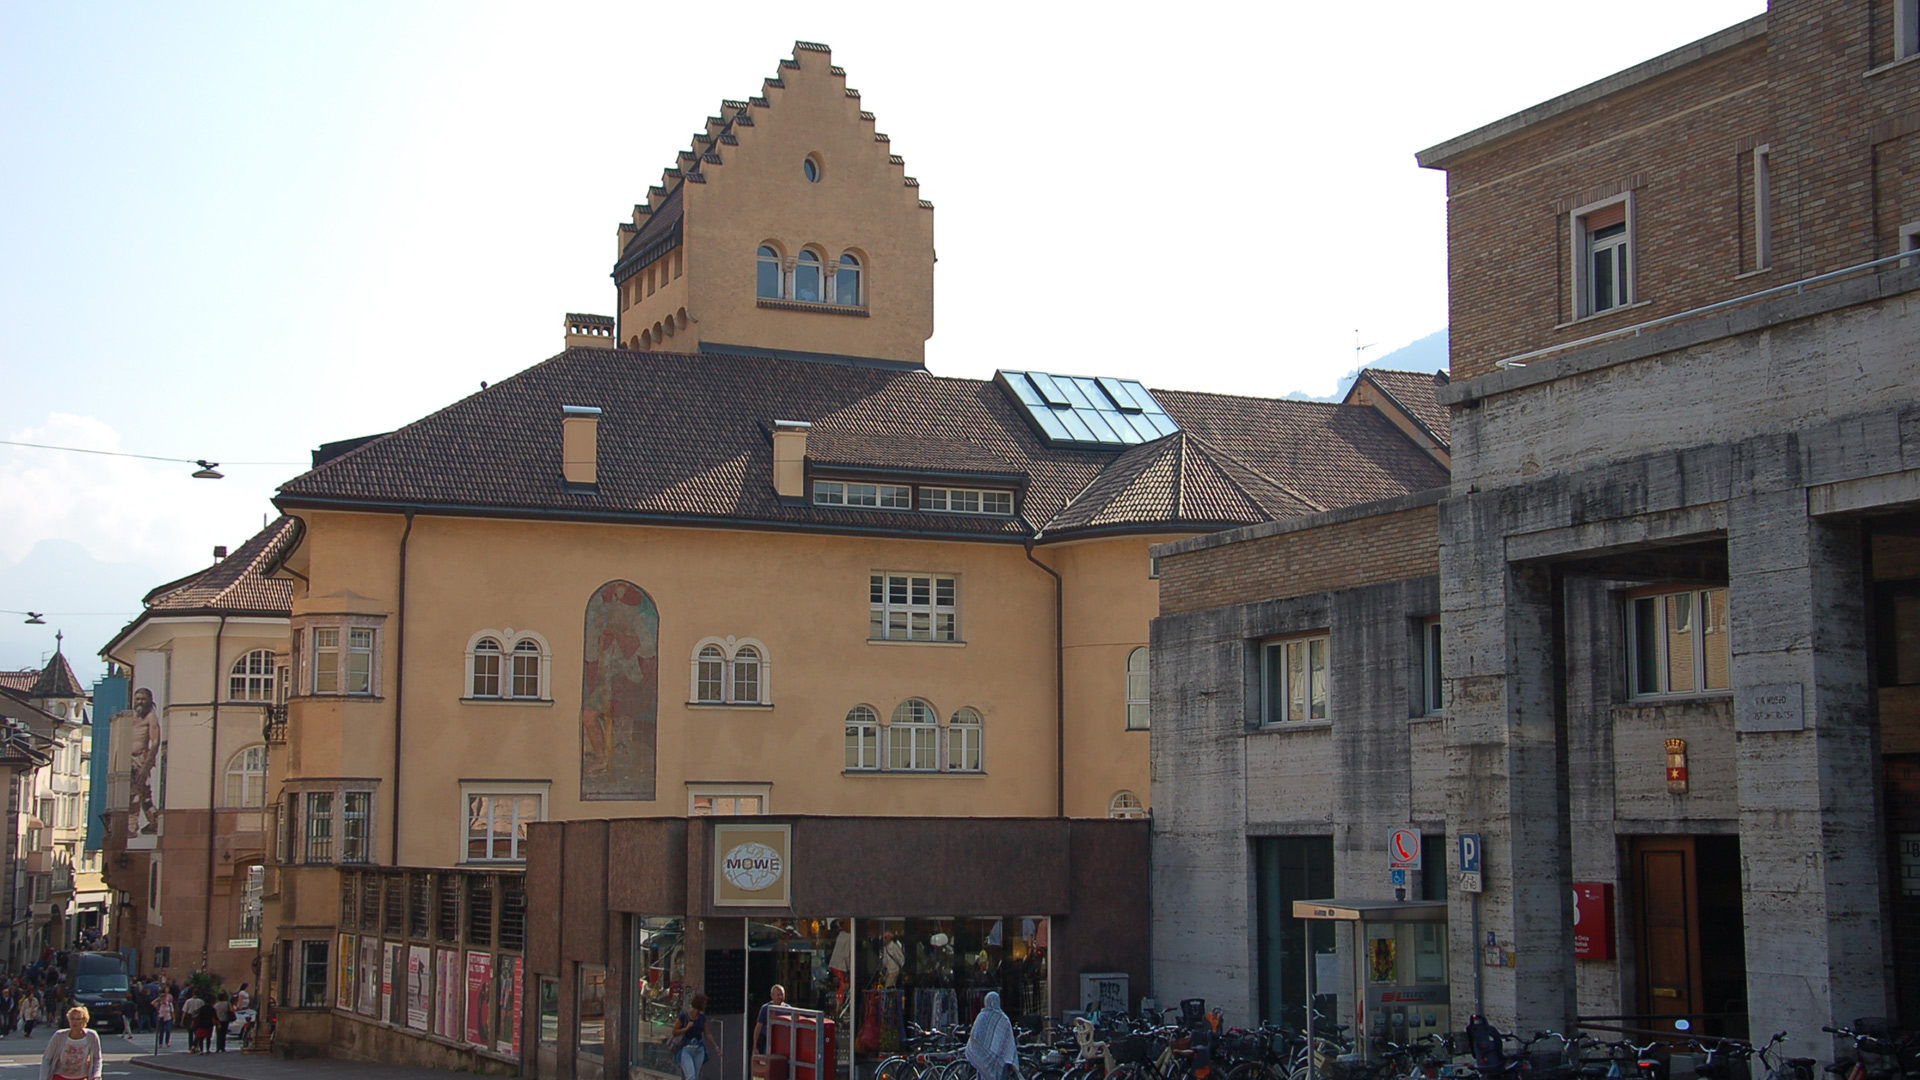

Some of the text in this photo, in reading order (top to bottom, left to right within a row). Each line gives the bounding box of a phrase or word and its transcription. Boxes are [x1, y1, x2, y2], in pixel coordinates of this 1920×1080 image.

[1767, 695, 1787, 705] MUSEO
[1463, 837, 1475, 868] P
[726, 858, 780, 871] MOWE
[1402, 990, 1436, 998] TELECOM
